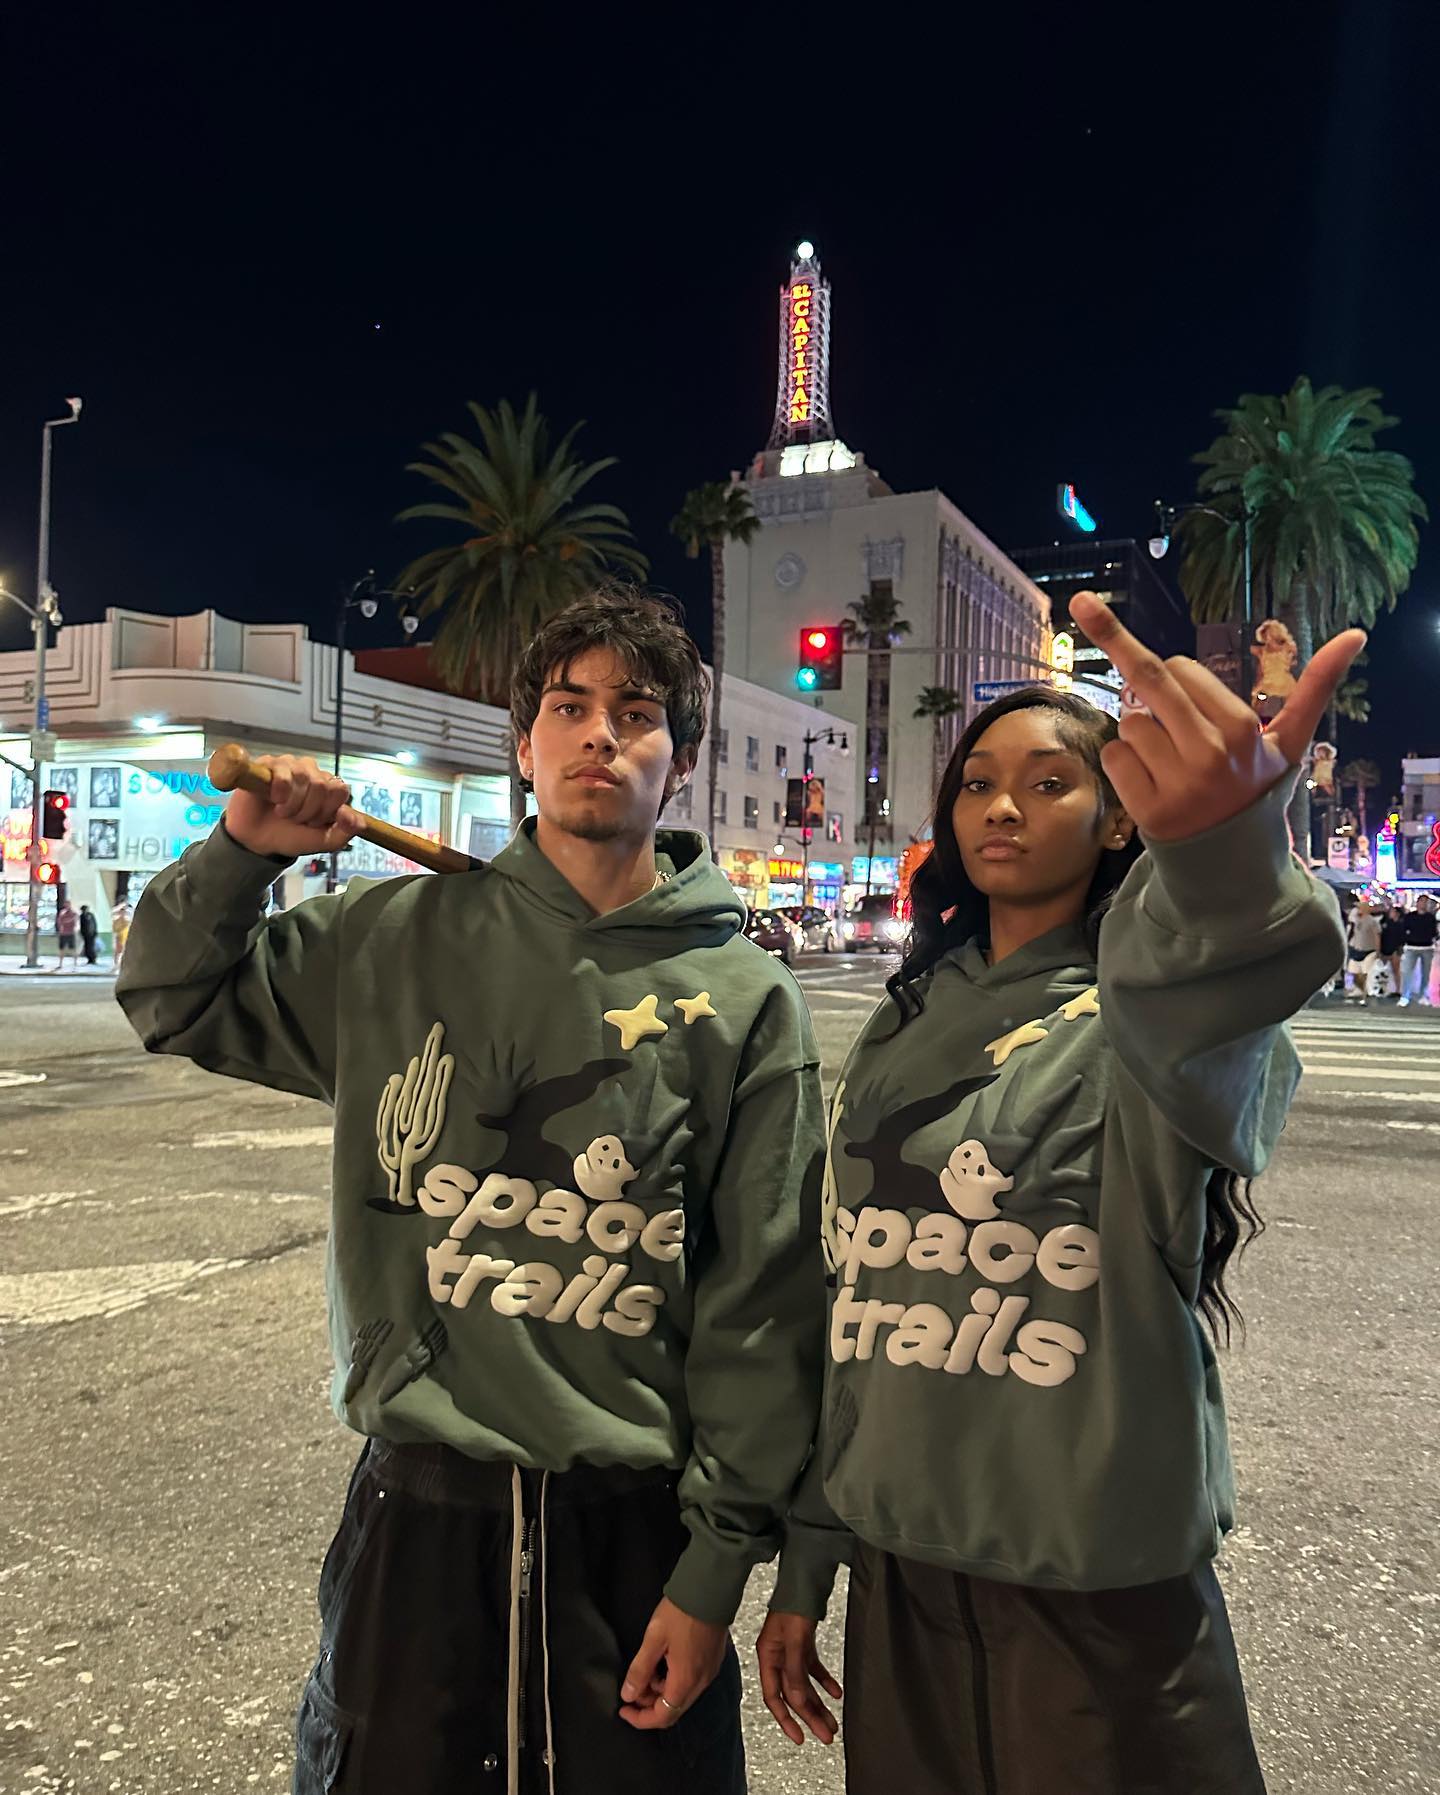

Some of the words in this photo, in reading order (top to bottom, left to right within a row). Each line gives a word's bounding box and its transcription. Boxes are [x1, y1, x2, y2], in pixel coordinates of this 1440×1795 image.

[792, 284, 811, 299] EL
[790, 300, 810, 422] CAPITAN
[125, 837, 190, 860] HOLL
[417, 1163, 685, 1262] space
[426, 1239, 665, 1337] trails
[831, 1286, 1087, 1387] trails
